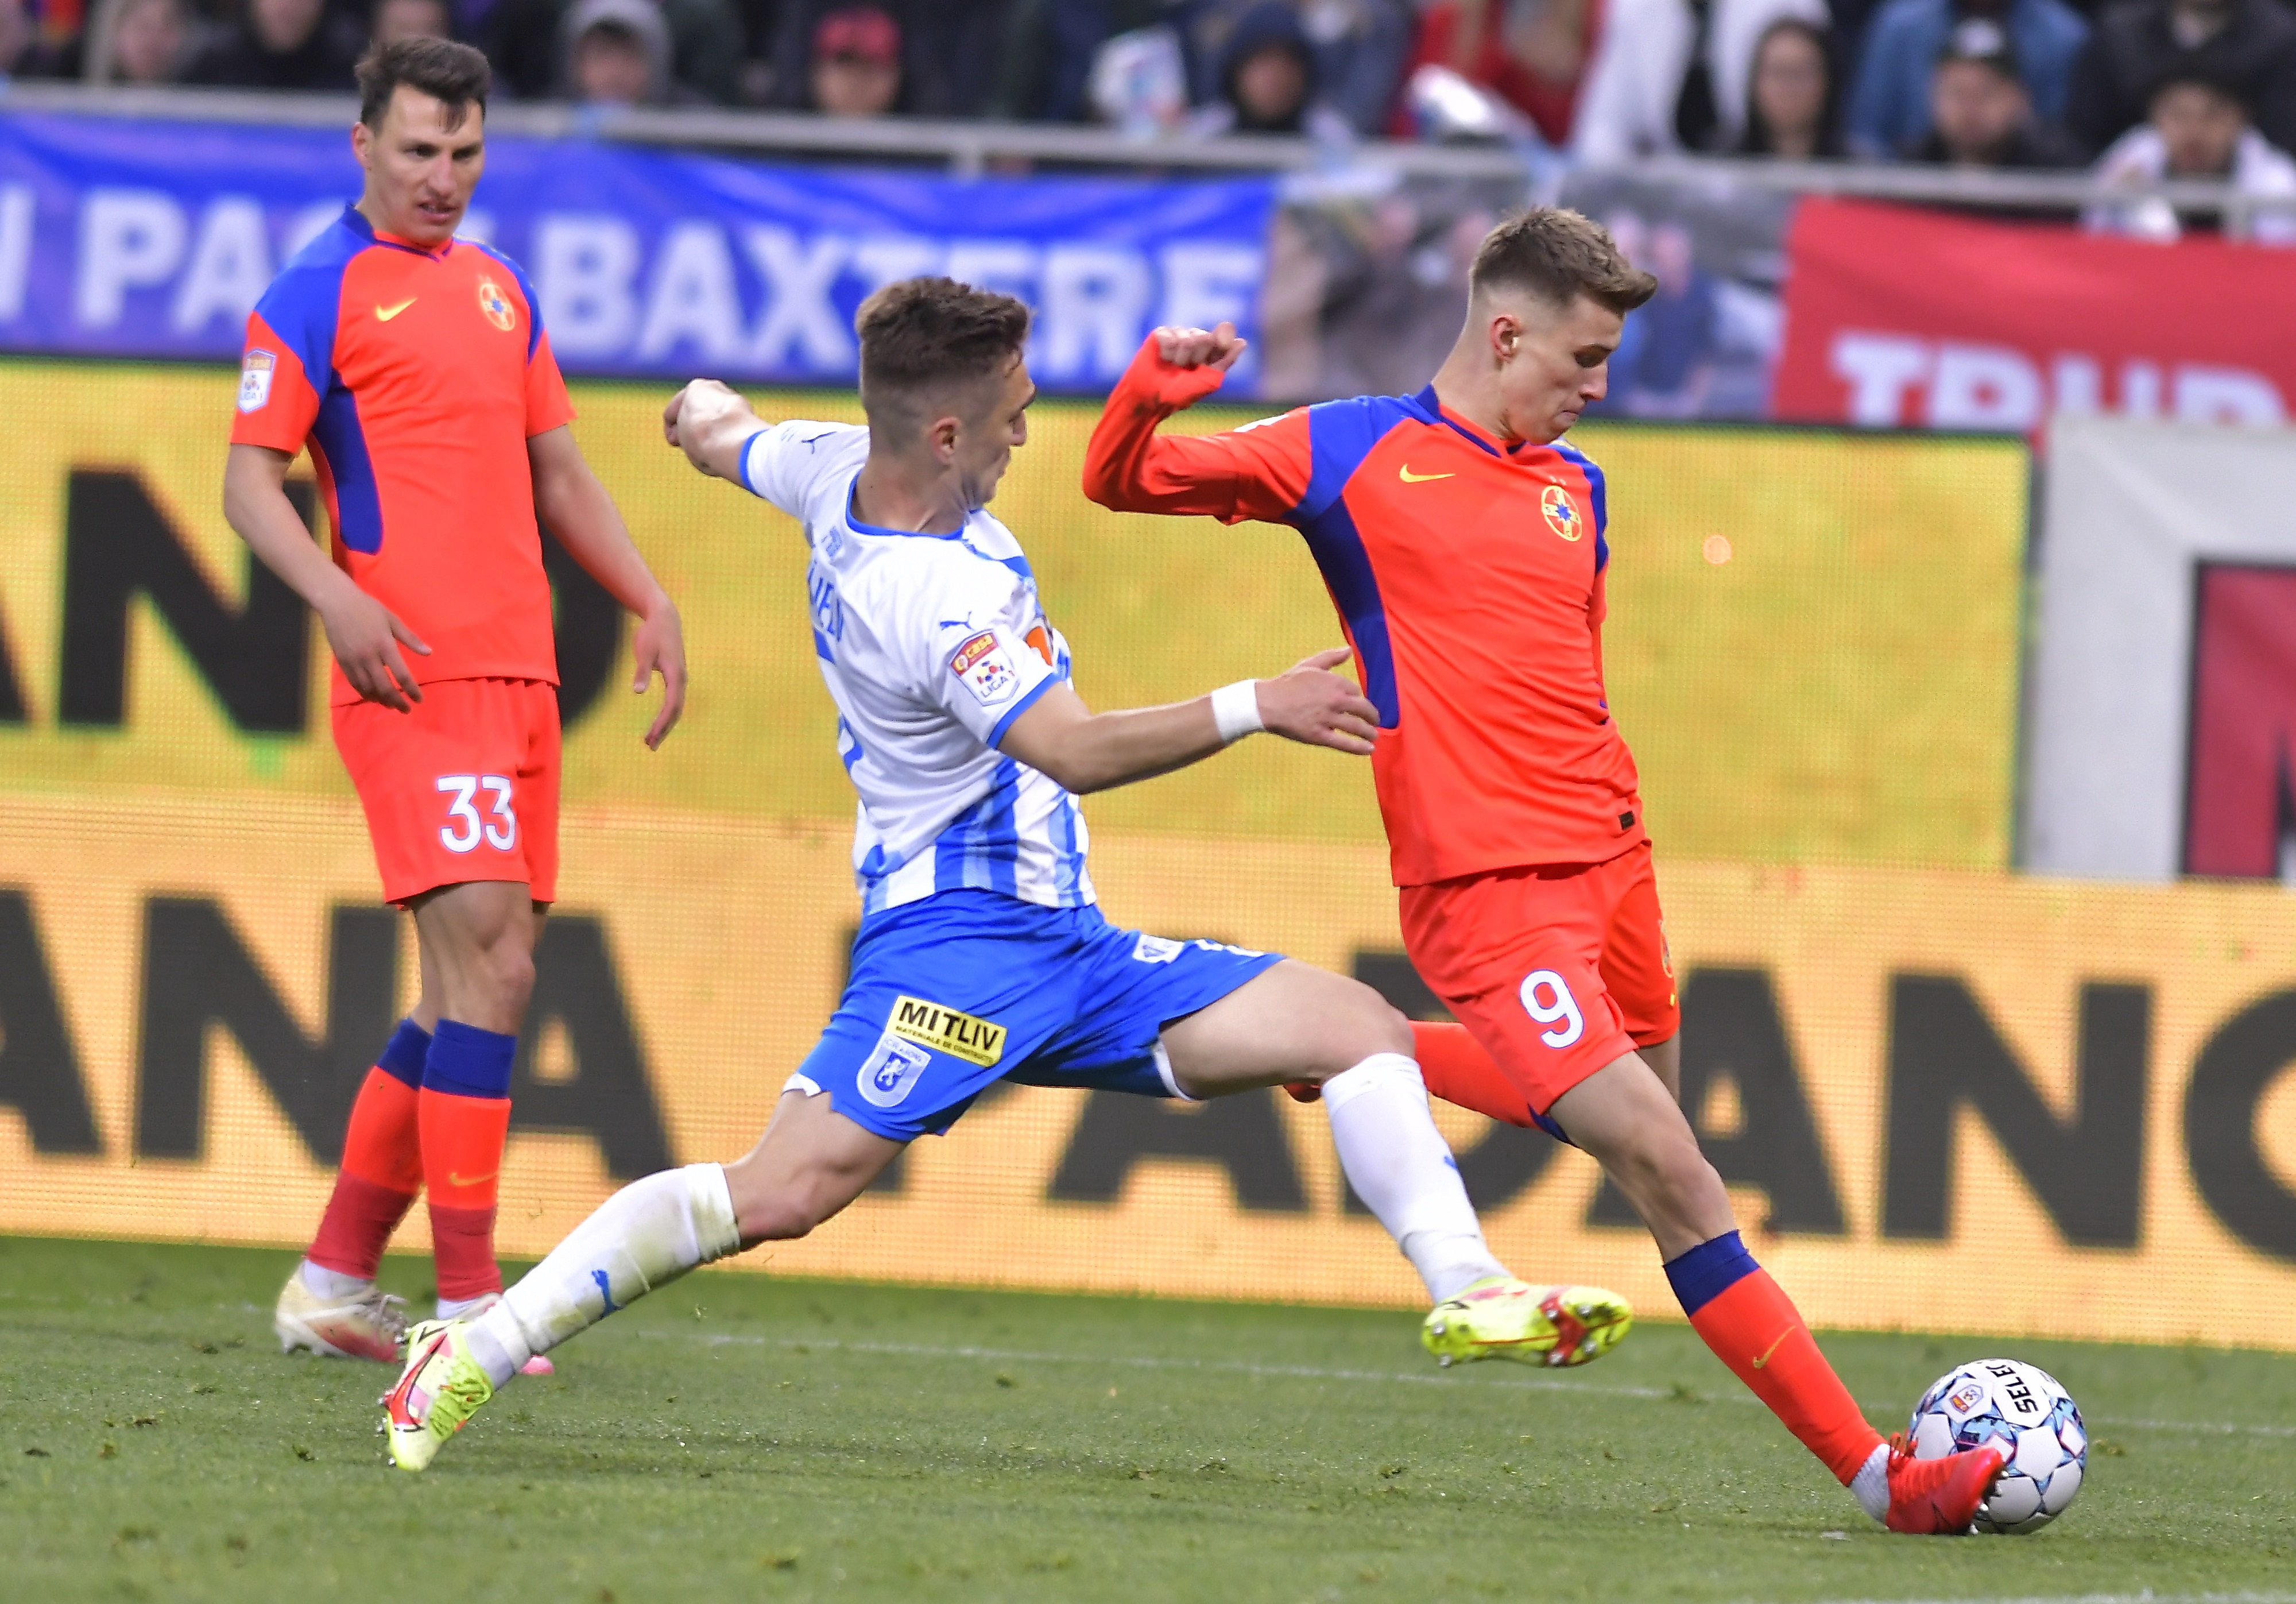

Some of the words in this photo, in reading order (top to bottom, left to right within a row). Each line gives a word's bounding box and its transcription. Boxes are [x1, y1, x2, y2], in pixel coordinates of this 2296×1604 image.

[533, 215, 1262, 382] BAXRE
[981, 676, 1009, 698] LIGA
[436, 775, 516, 853] 33
[898, 1001, 1000, 1051] MITLIV
[1520, 969, 1585, 1049] 9
